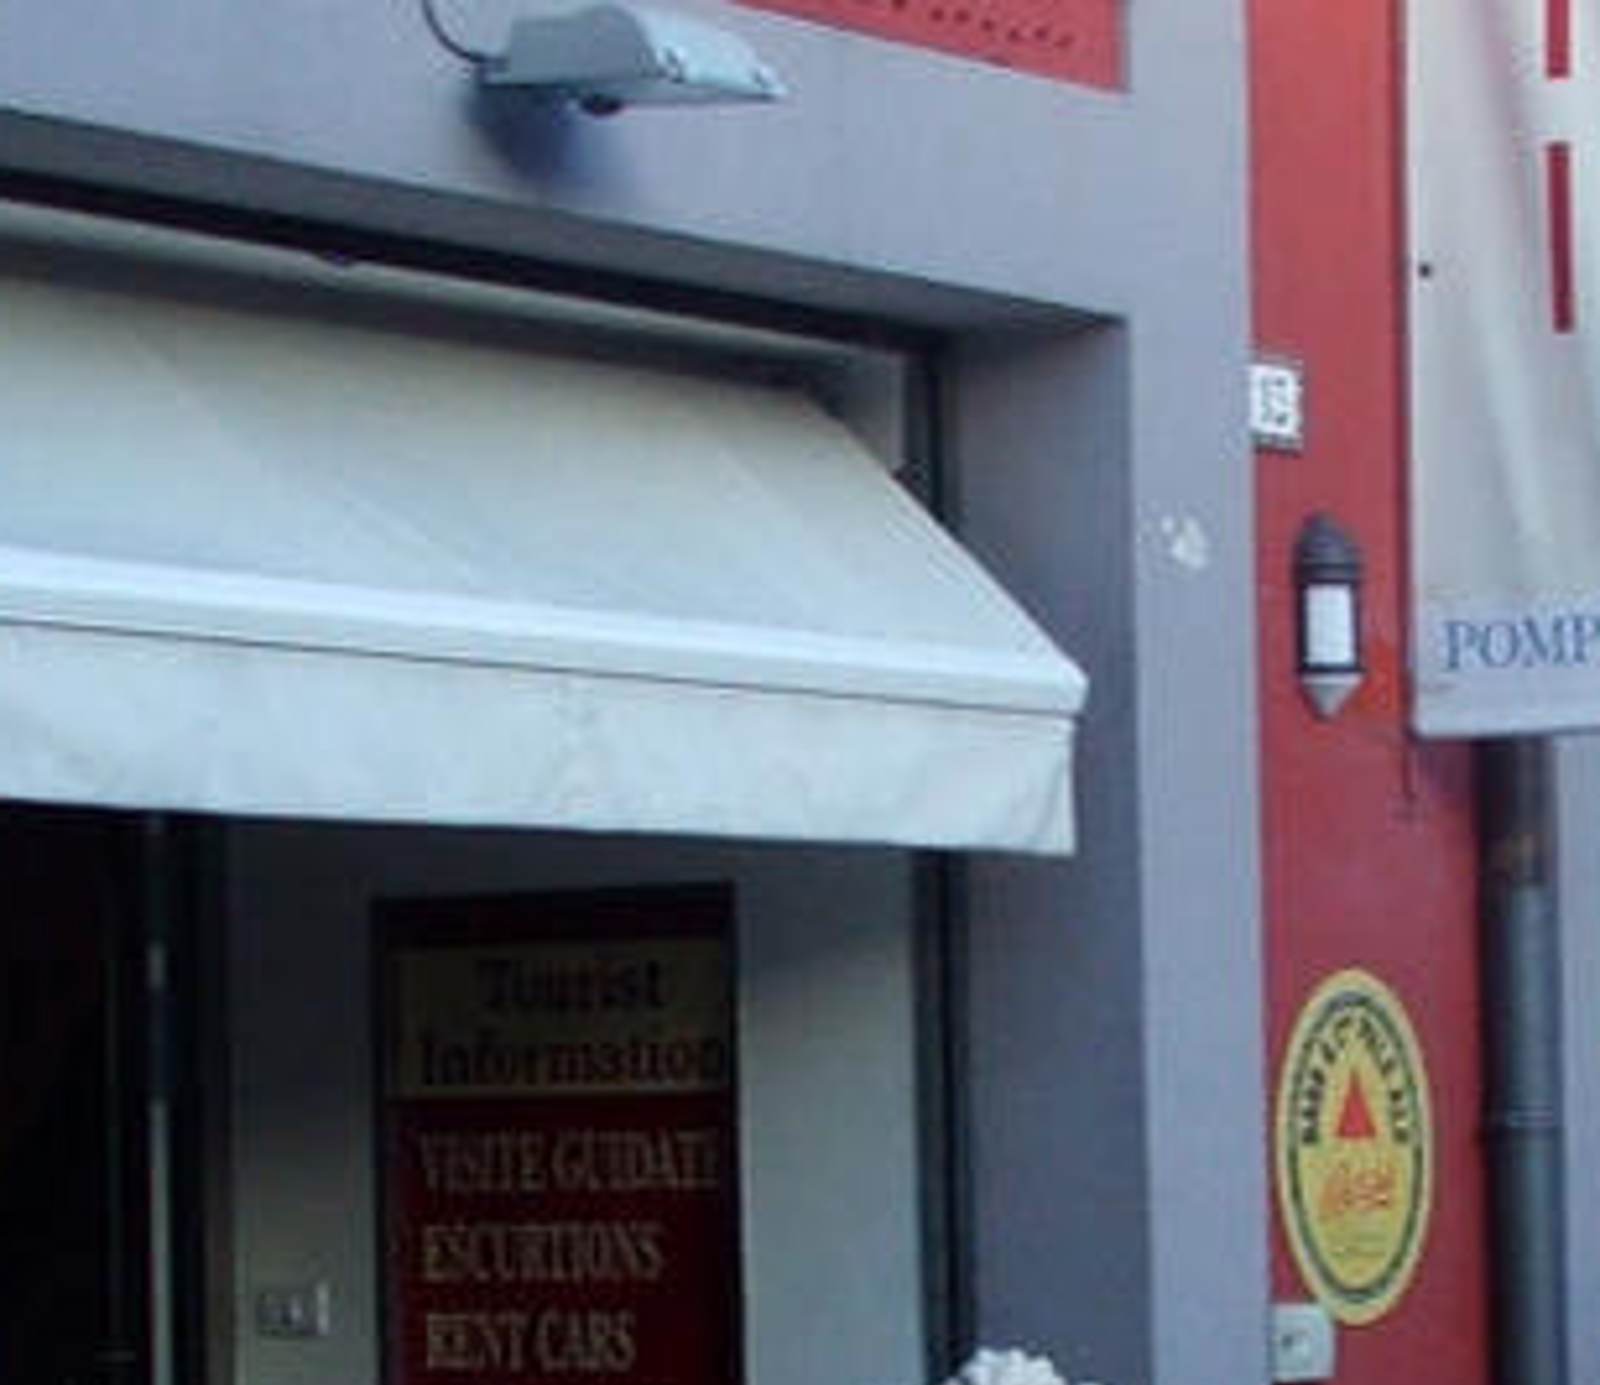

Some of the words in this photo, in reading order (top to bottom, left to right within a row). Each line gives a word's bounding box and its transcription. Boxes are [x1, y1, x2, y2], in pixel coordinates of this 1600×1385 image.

[477, 958, 666, 1008] Tourist
[420, 1027, 724, 1084] Information
[419, 1128, 547, 1193] VISITE
[426, 1310, 529, 1373] RENT
[532, 1308, 638, 1374] CARS
